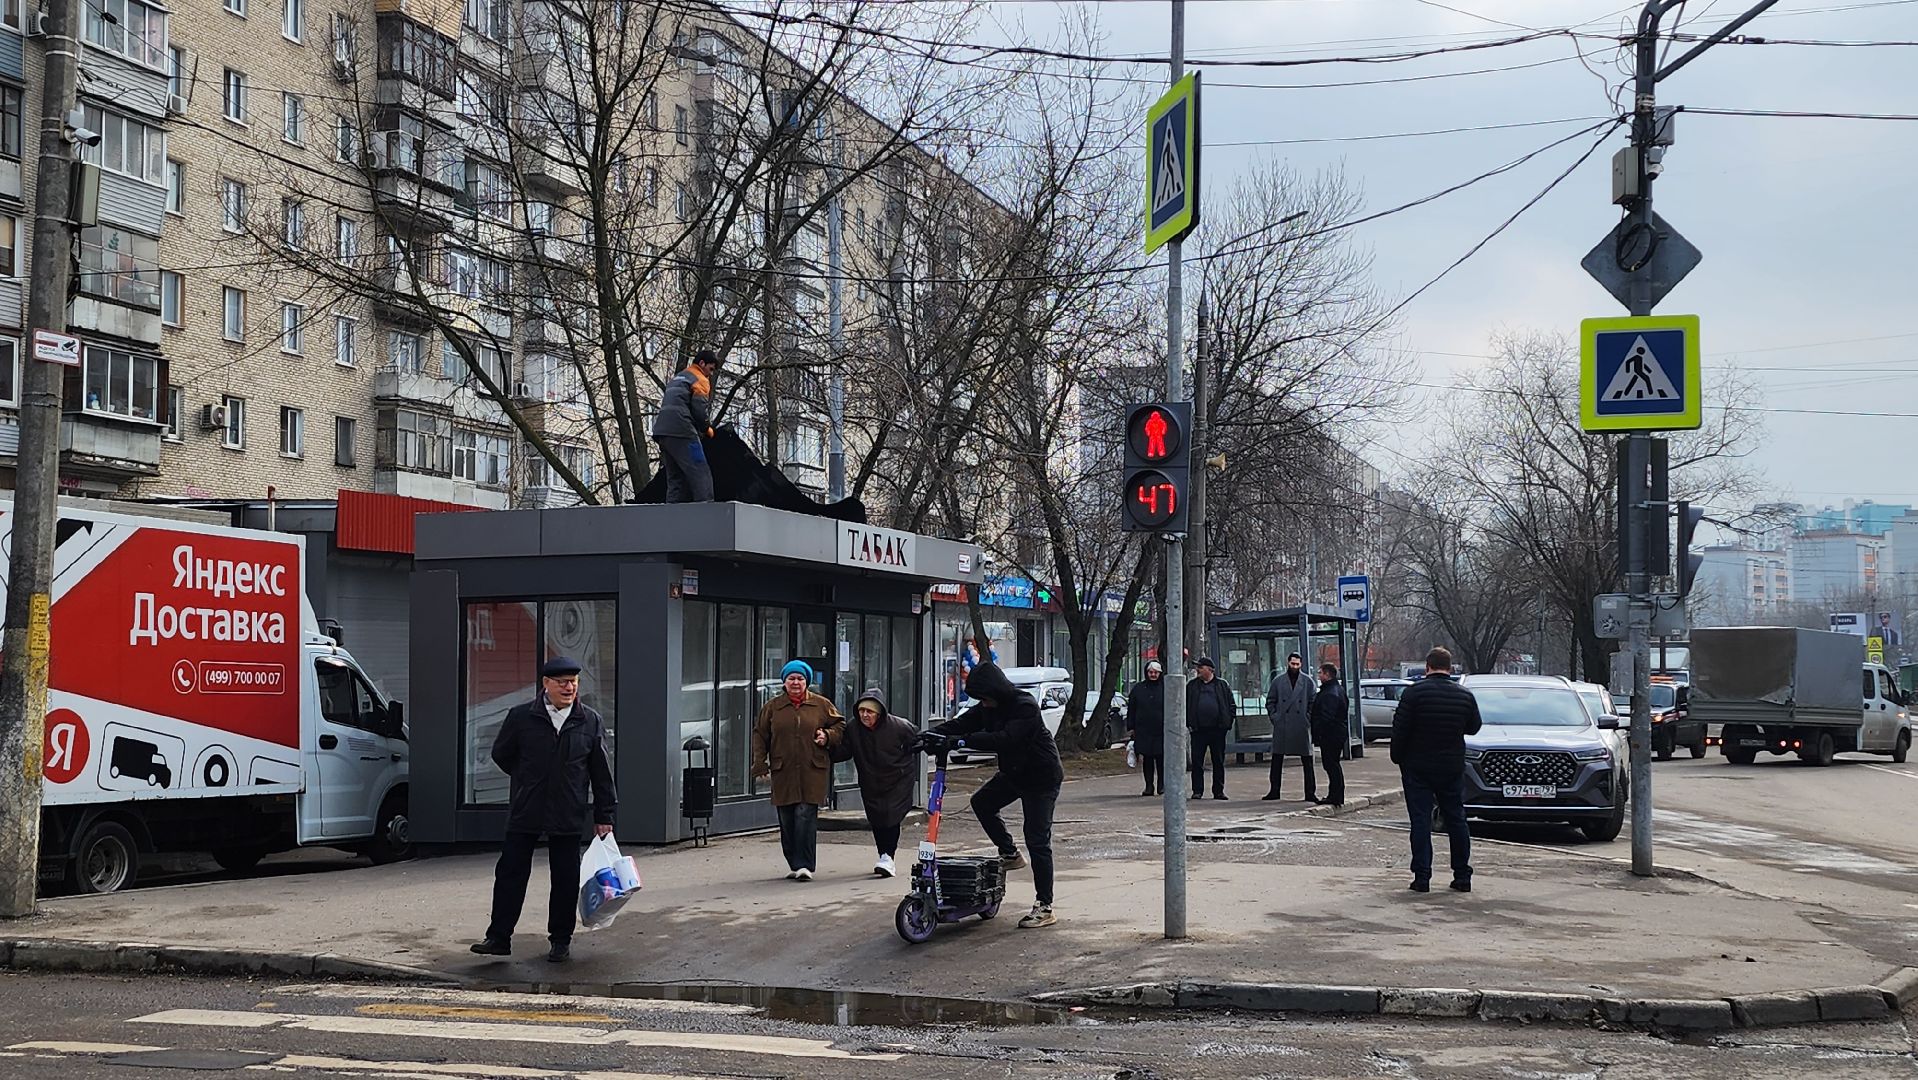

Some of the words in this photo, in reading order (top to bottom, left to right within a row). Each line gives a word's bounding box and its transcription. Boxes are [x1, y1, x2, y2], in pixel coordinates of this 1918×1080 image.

[1138, 484, 1175, 515] 47
[847, 528, 908, 567] ТАБАК
[172, 545, 286, 599] Яндекс
[129, 592, 285, 646] Доставка
[205, 669, 232, 686] (499)
[234, 671, 253, 685] 700
[254, 671, 267, 685] 00
[268, 672, 281, 685] 07
[46, 723, 76, 771] Я
